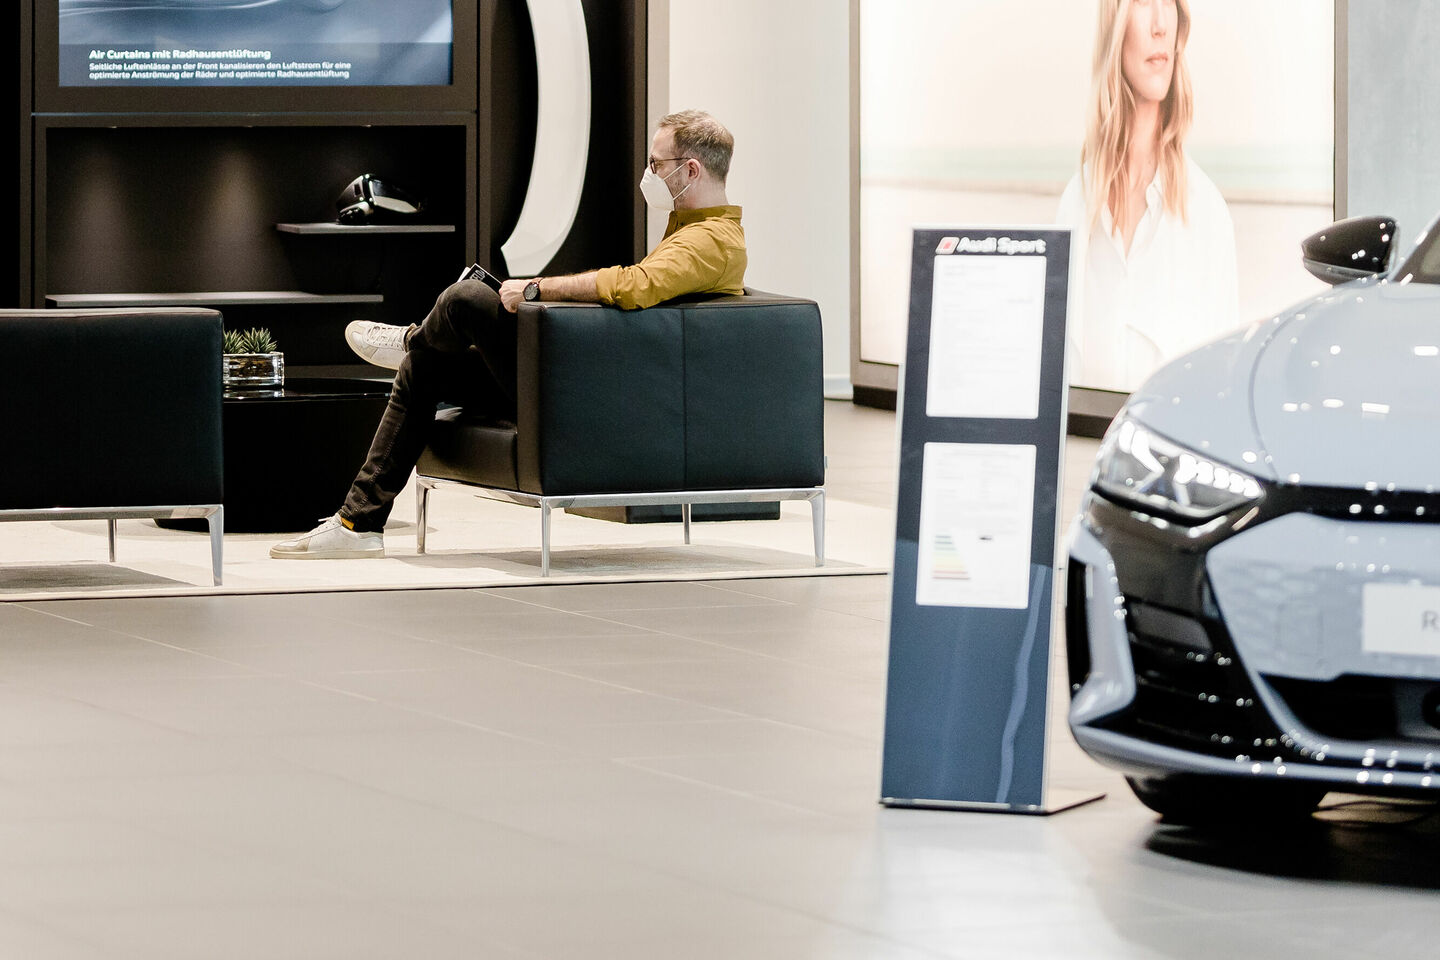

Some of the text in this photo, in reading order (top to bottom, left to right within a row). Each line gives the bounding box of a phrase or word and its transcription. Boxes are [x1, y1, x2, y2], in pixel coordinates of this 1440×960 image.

[88, 49, 272, 61] Air Curtains mit Radhausentlüftung
[89, 61, 352, 71] Seitliche Lufteinlässe an der Front kanalisieren den Luftstrom für eine
[89, 70, 350, 80] optimierte Anströmung der Räder und optimierte Radhausentlüftung
[956, 237, 1047, 256] Audi Sport
